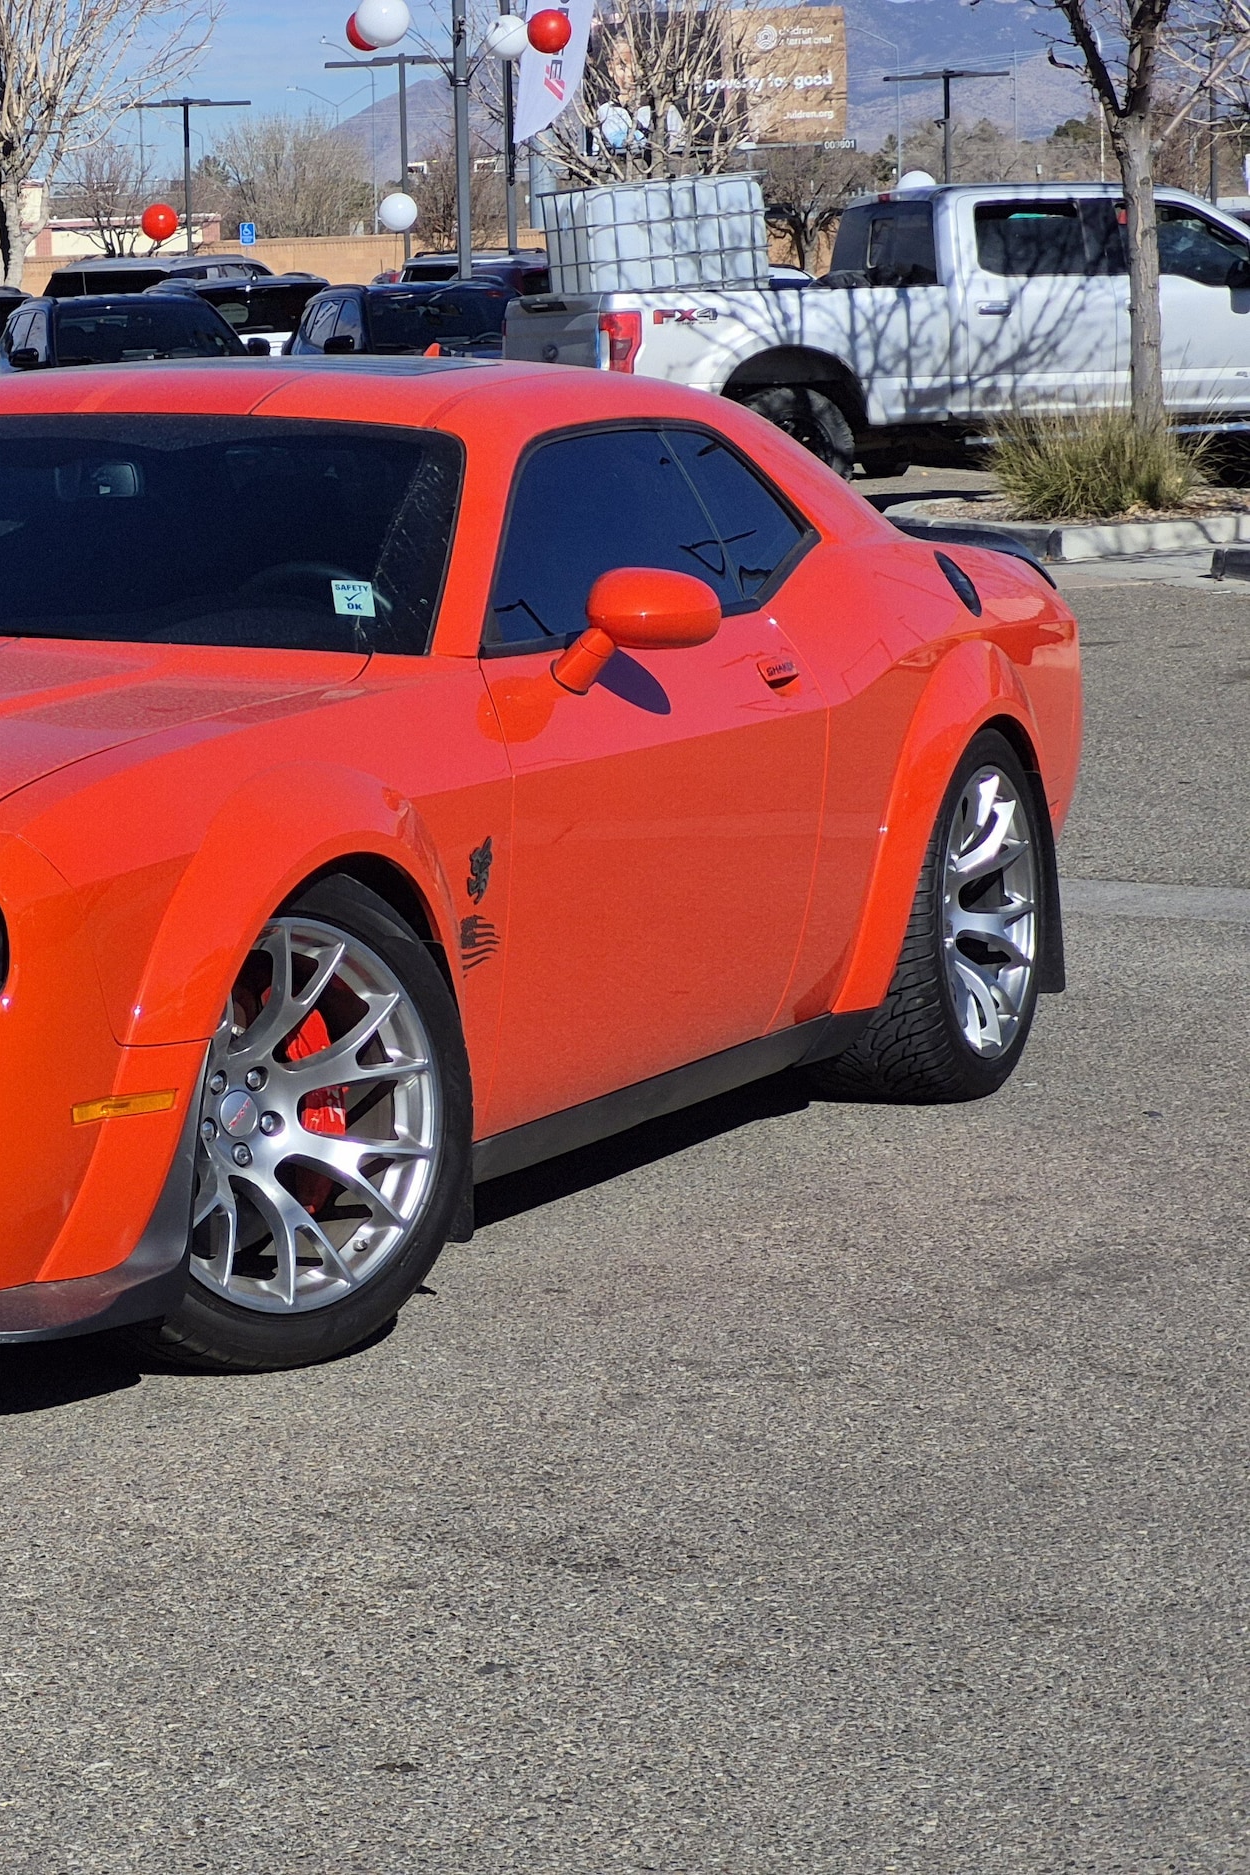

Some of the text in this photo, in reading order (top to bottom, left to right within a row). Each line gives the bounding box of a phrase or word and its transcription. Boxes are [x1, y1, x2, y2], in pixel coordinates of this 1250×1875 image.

[794, 70, 833, 90] good
[653, 308, 718, 324] FX4
[335, 584, 368, 592] SAFETY
[347, 602, 363, 610] OK
